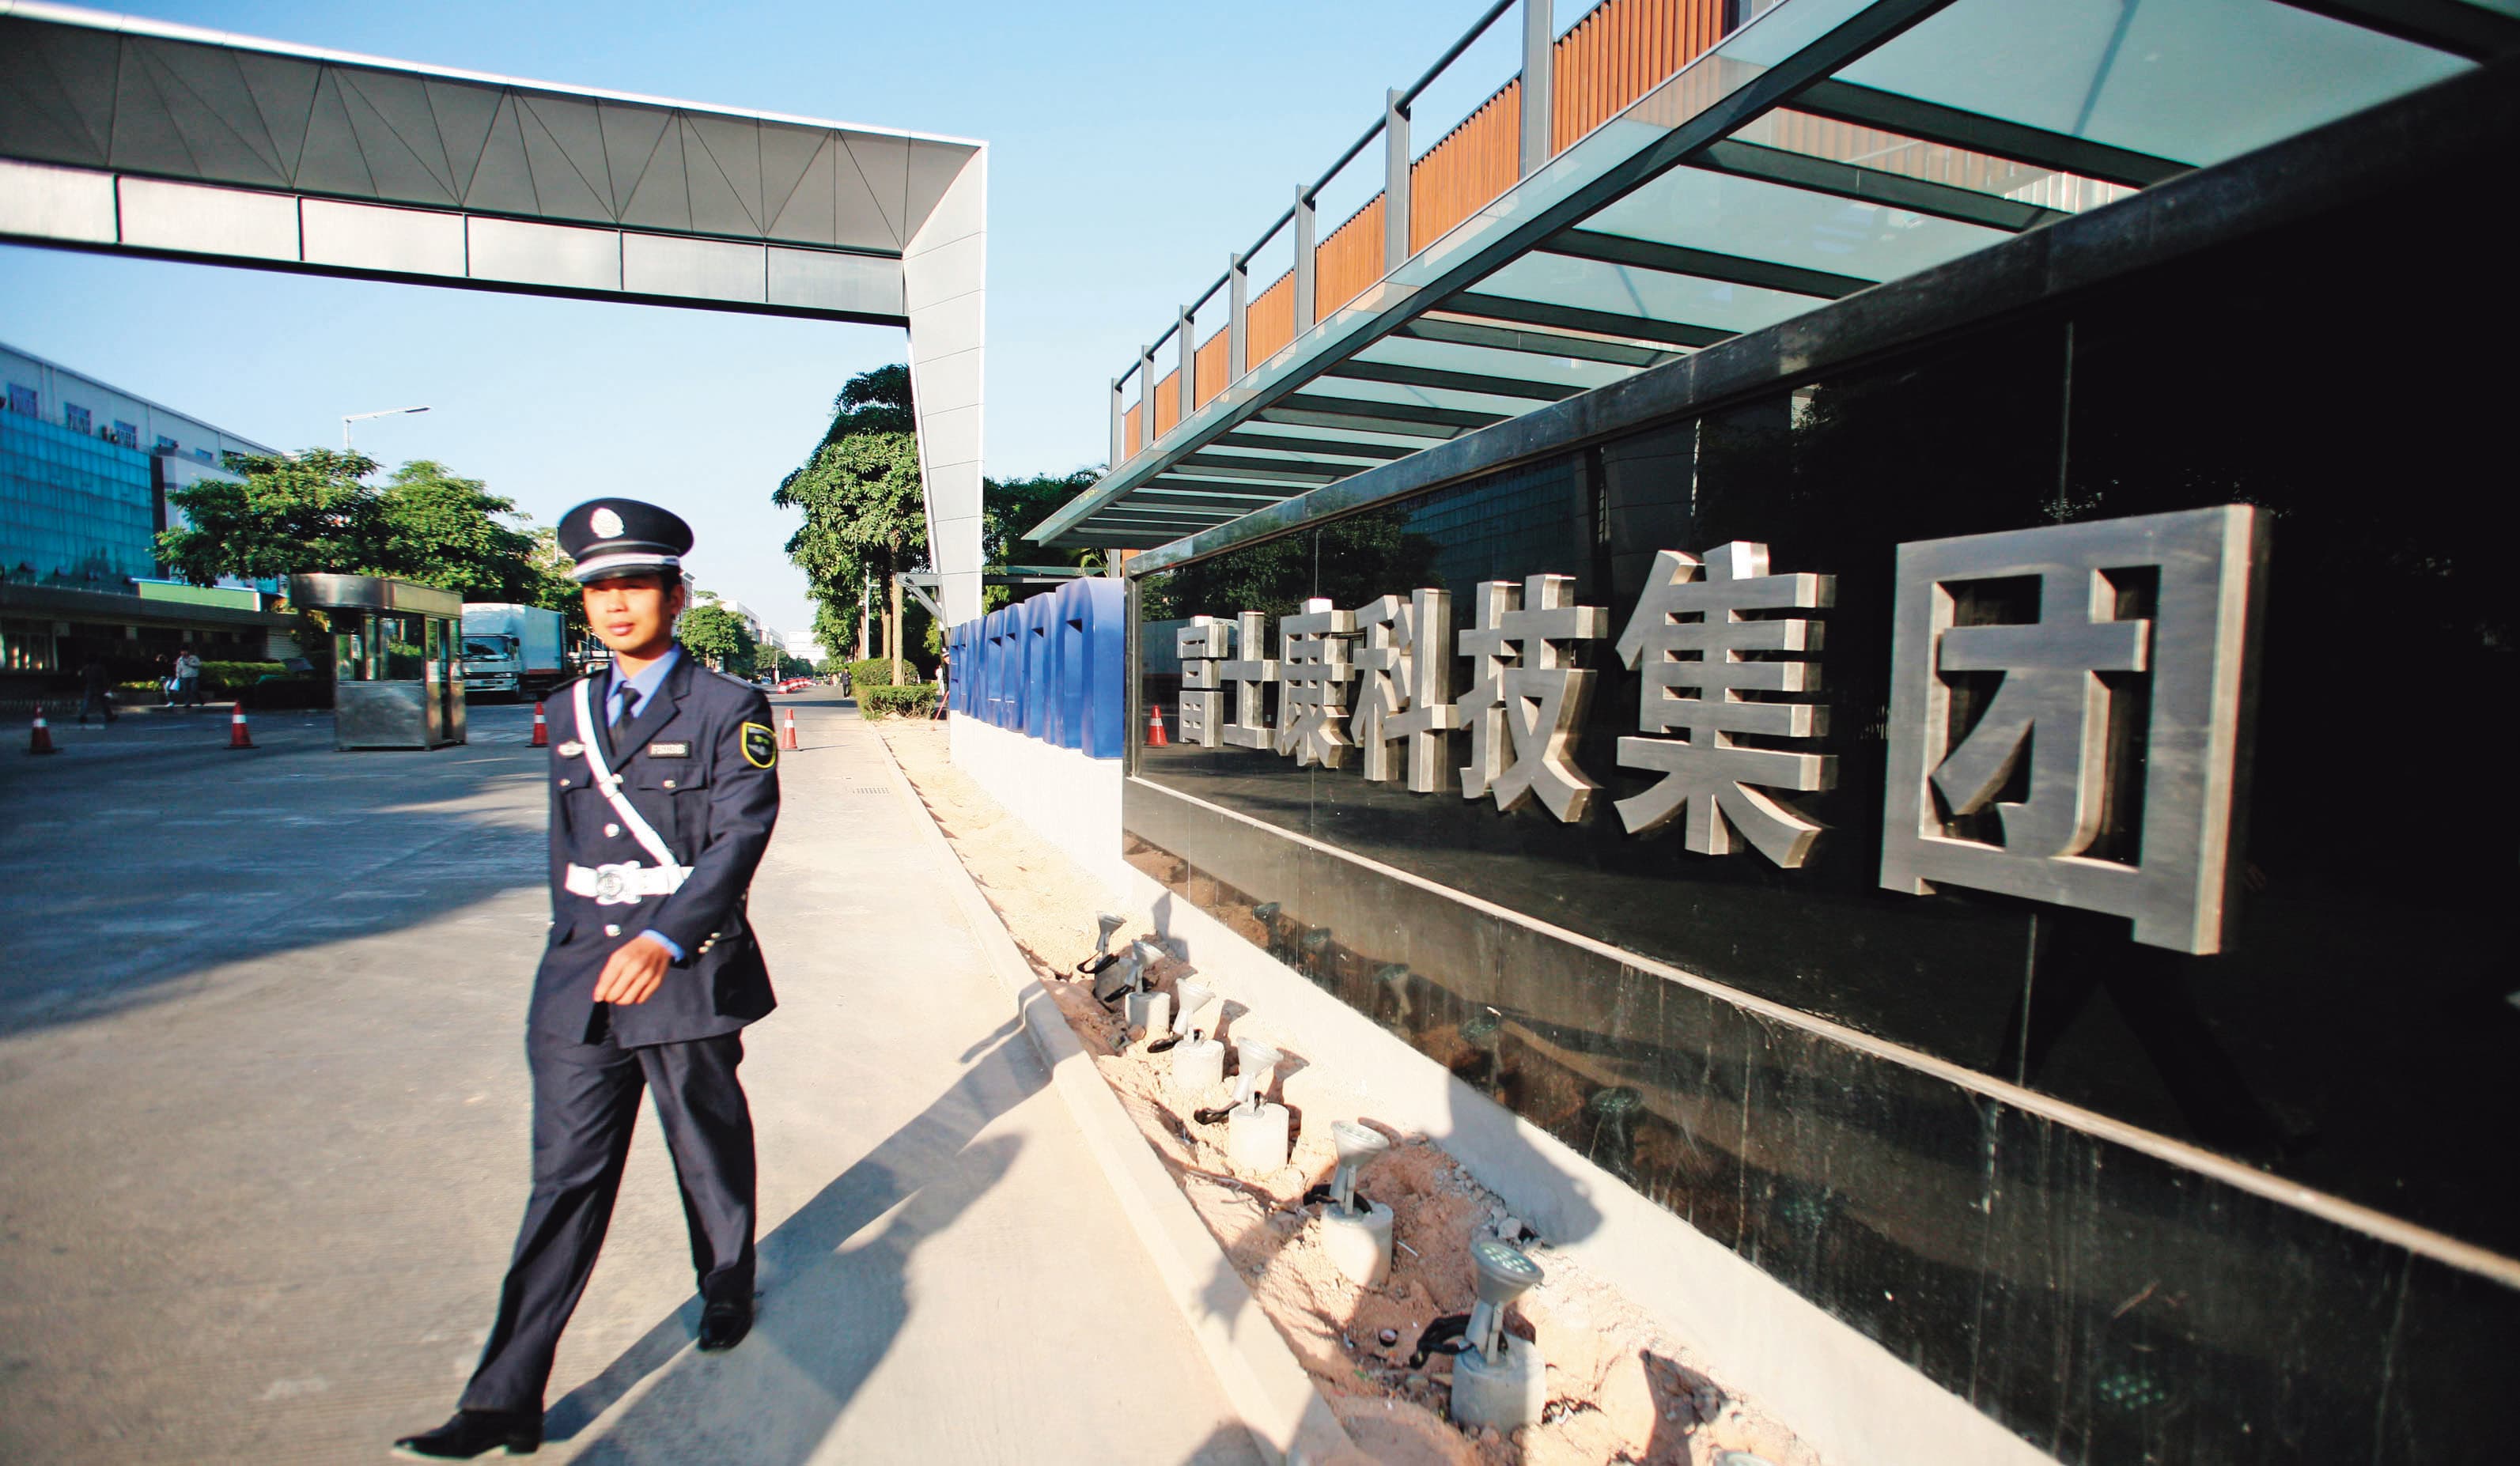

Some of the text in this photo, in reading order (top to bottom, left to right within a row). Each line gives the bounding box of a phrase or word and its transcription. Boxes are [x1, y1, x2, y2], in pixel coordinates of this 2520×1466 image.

[1177, 504, 2270, 956] 富士康科技集团
